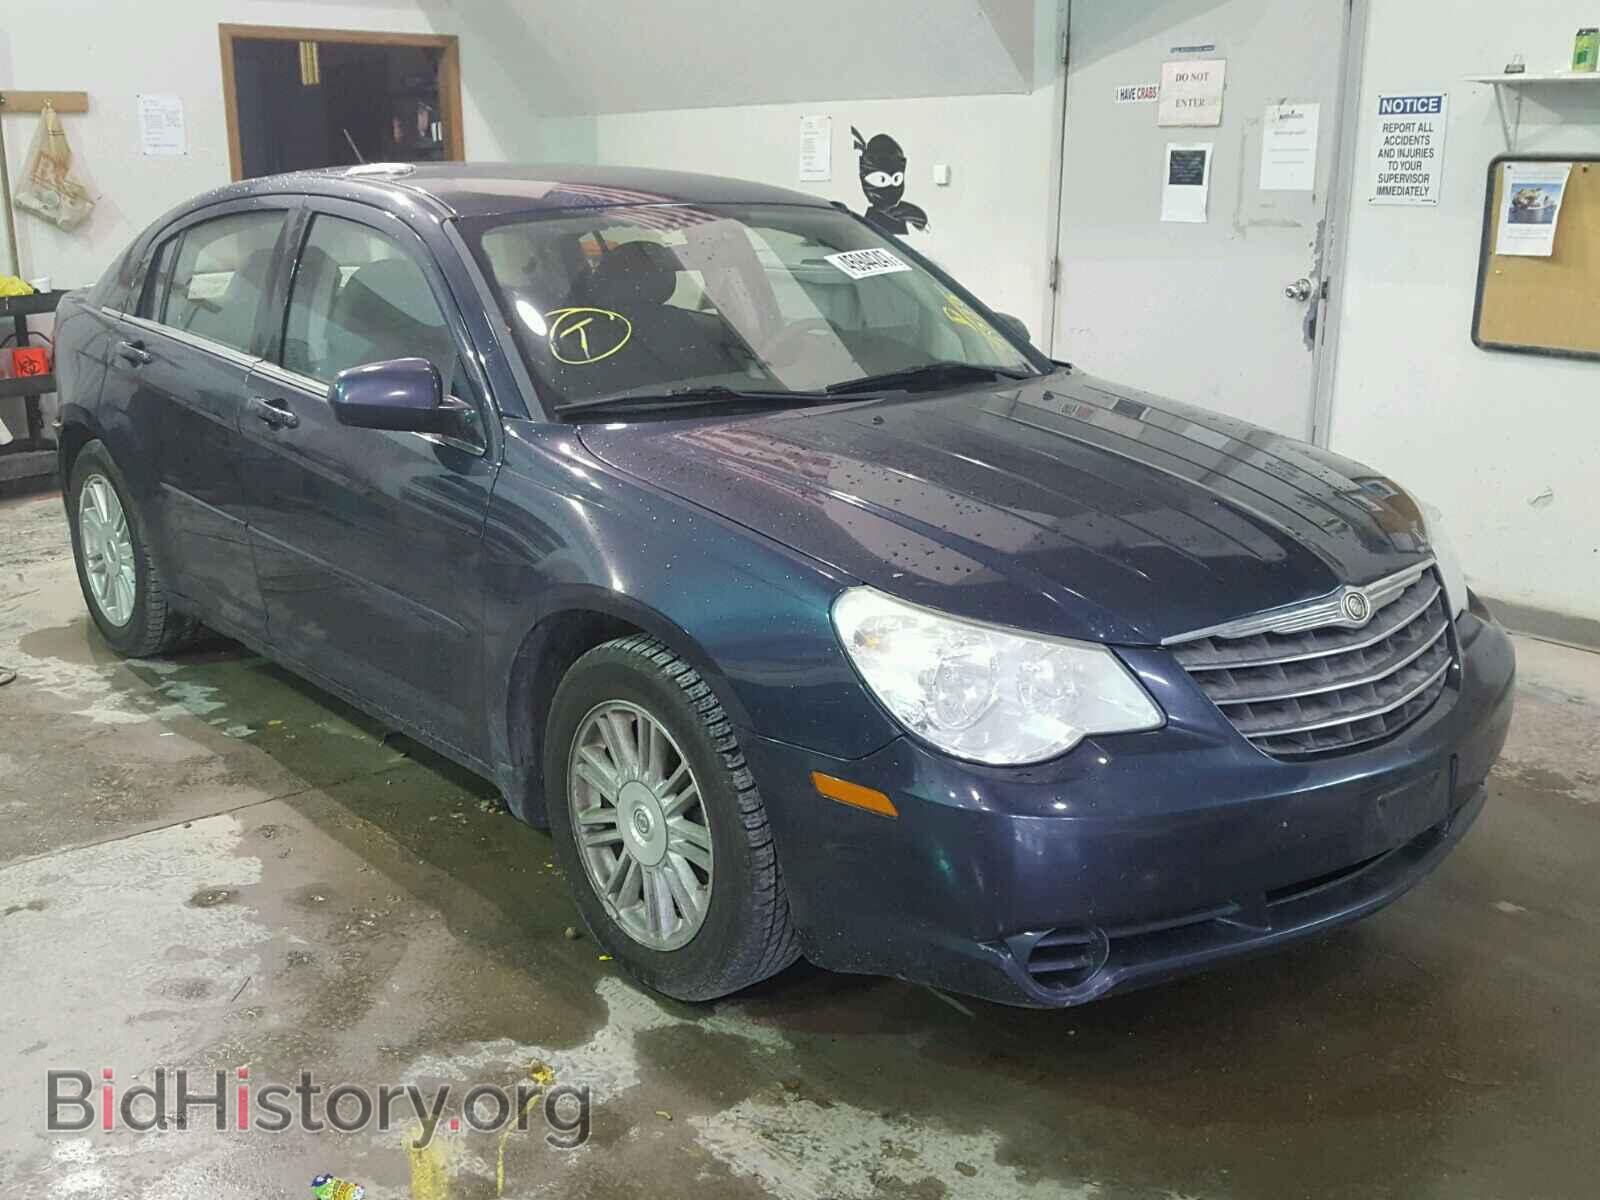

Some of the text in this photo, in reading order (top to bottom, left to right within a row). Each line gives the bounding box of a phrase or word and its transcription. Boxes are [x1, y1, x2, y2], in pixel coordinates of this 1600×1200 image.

[1175, 71, 1211, 82] DO NOT
[1120, 87, 1137, 100] HAVE
[1175, 98, 1206, 108] ENTER
[1381, 97, 1440, 114] NOTICE
[1382, 121, 1434, 133] REPORT ALL
[1383, 135, 1431, 146] ACCIDENTS
[1377, 147, 1435, 159] AND INJURIES
[1388, 160, 1423, 171] TO YOUR
[1378, 173, 1431, 184] SUPERVISOR
[1376, 185, 1430, 197] IMMEDIATELY
[559, 317, 593, 360] T
